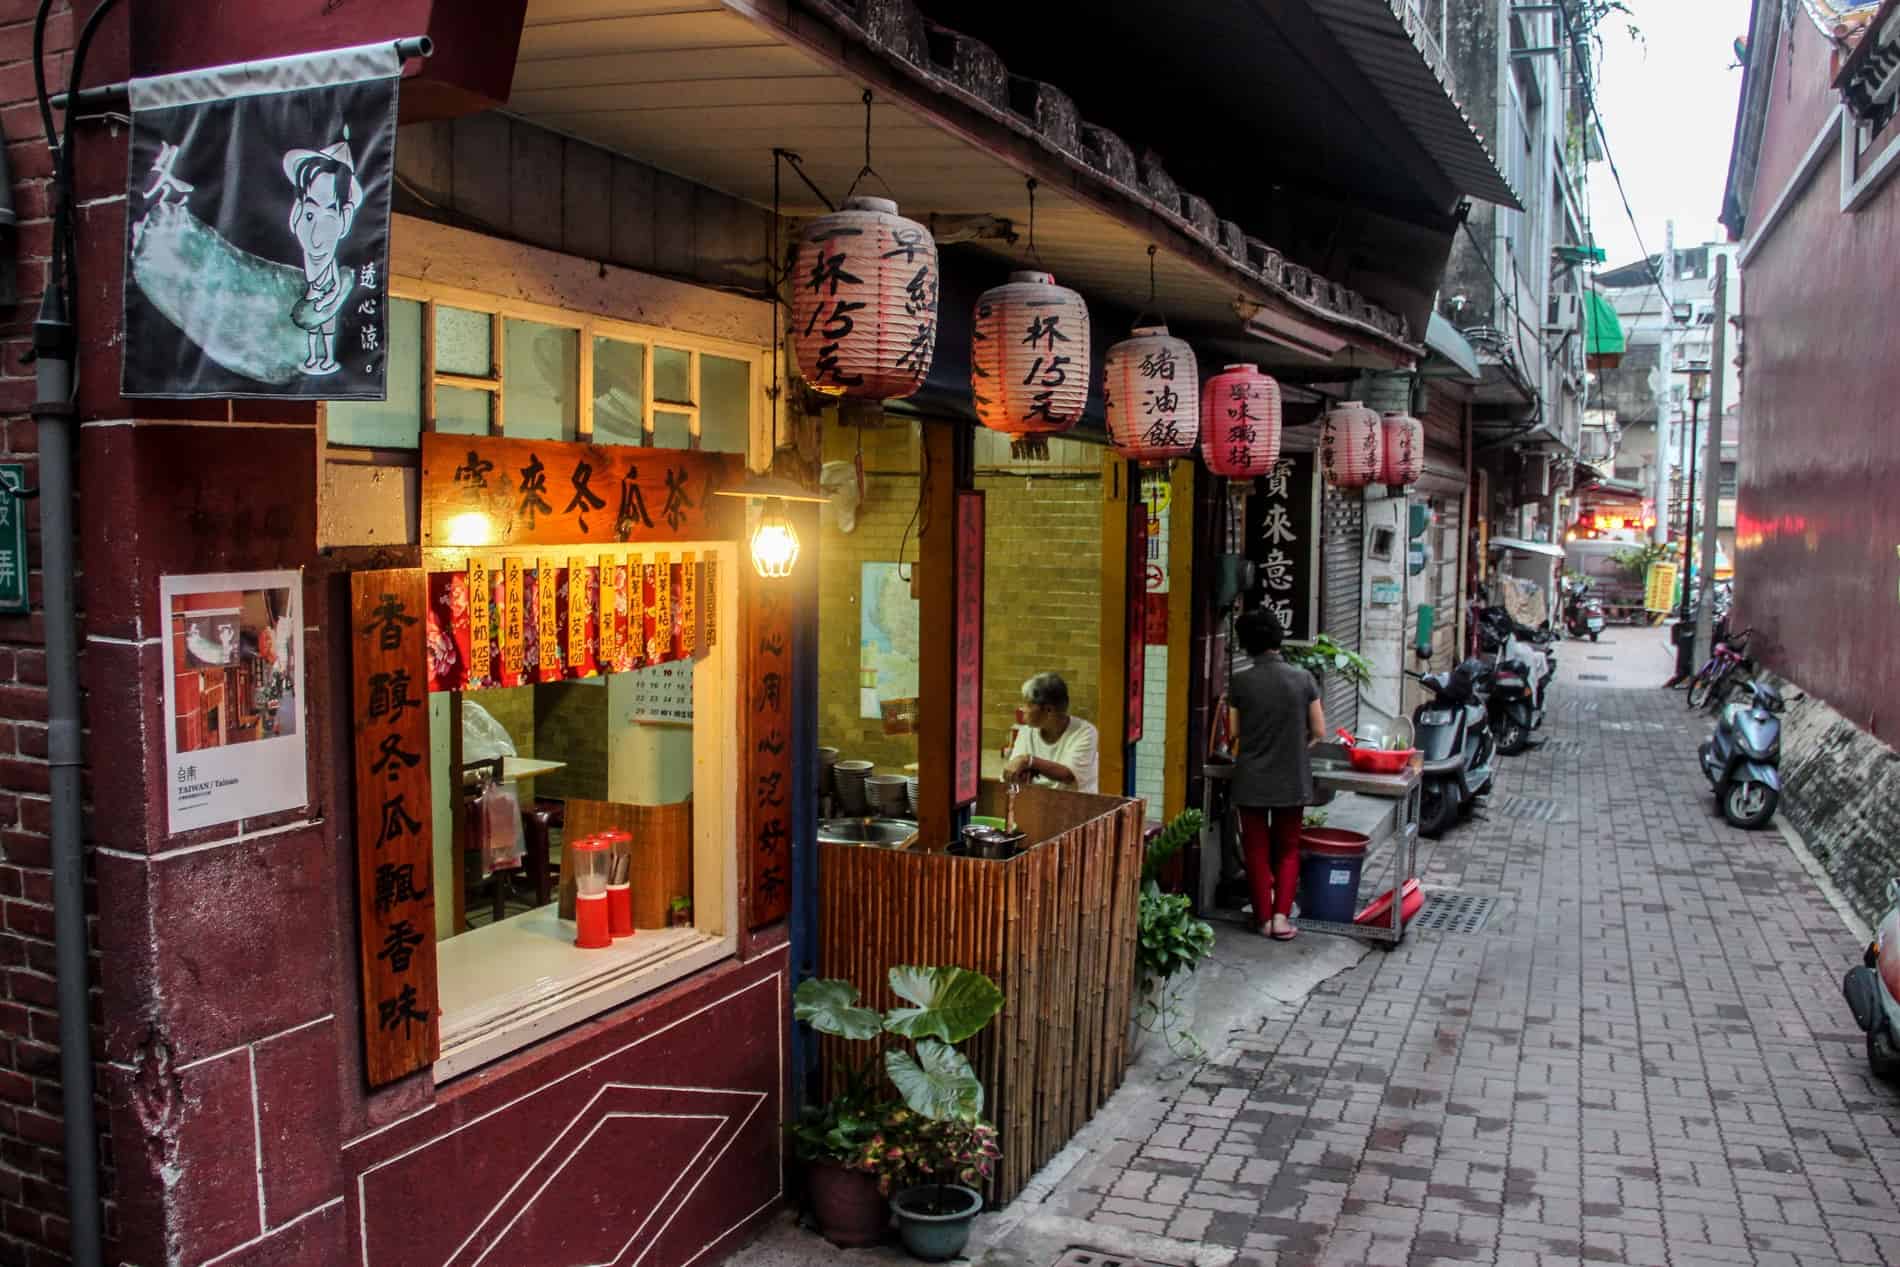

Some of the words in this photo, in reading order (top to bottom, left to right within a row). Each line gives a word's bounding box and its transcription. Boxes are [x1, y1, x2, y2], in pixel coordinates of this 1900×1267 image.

[357, 264, 380, 374] 透心涼。
[804, 228, 864, 387] 一杯15元
[1021, 299, 1071, 424] 一杯15元
[1138, 347, 1185, 448] 豬油飯
[663, 669, 672, 677] 10
[178, 782, 209, 795] TAIWAN
[363, 593, 429, 1041] 香醇冬瓜飄香味
